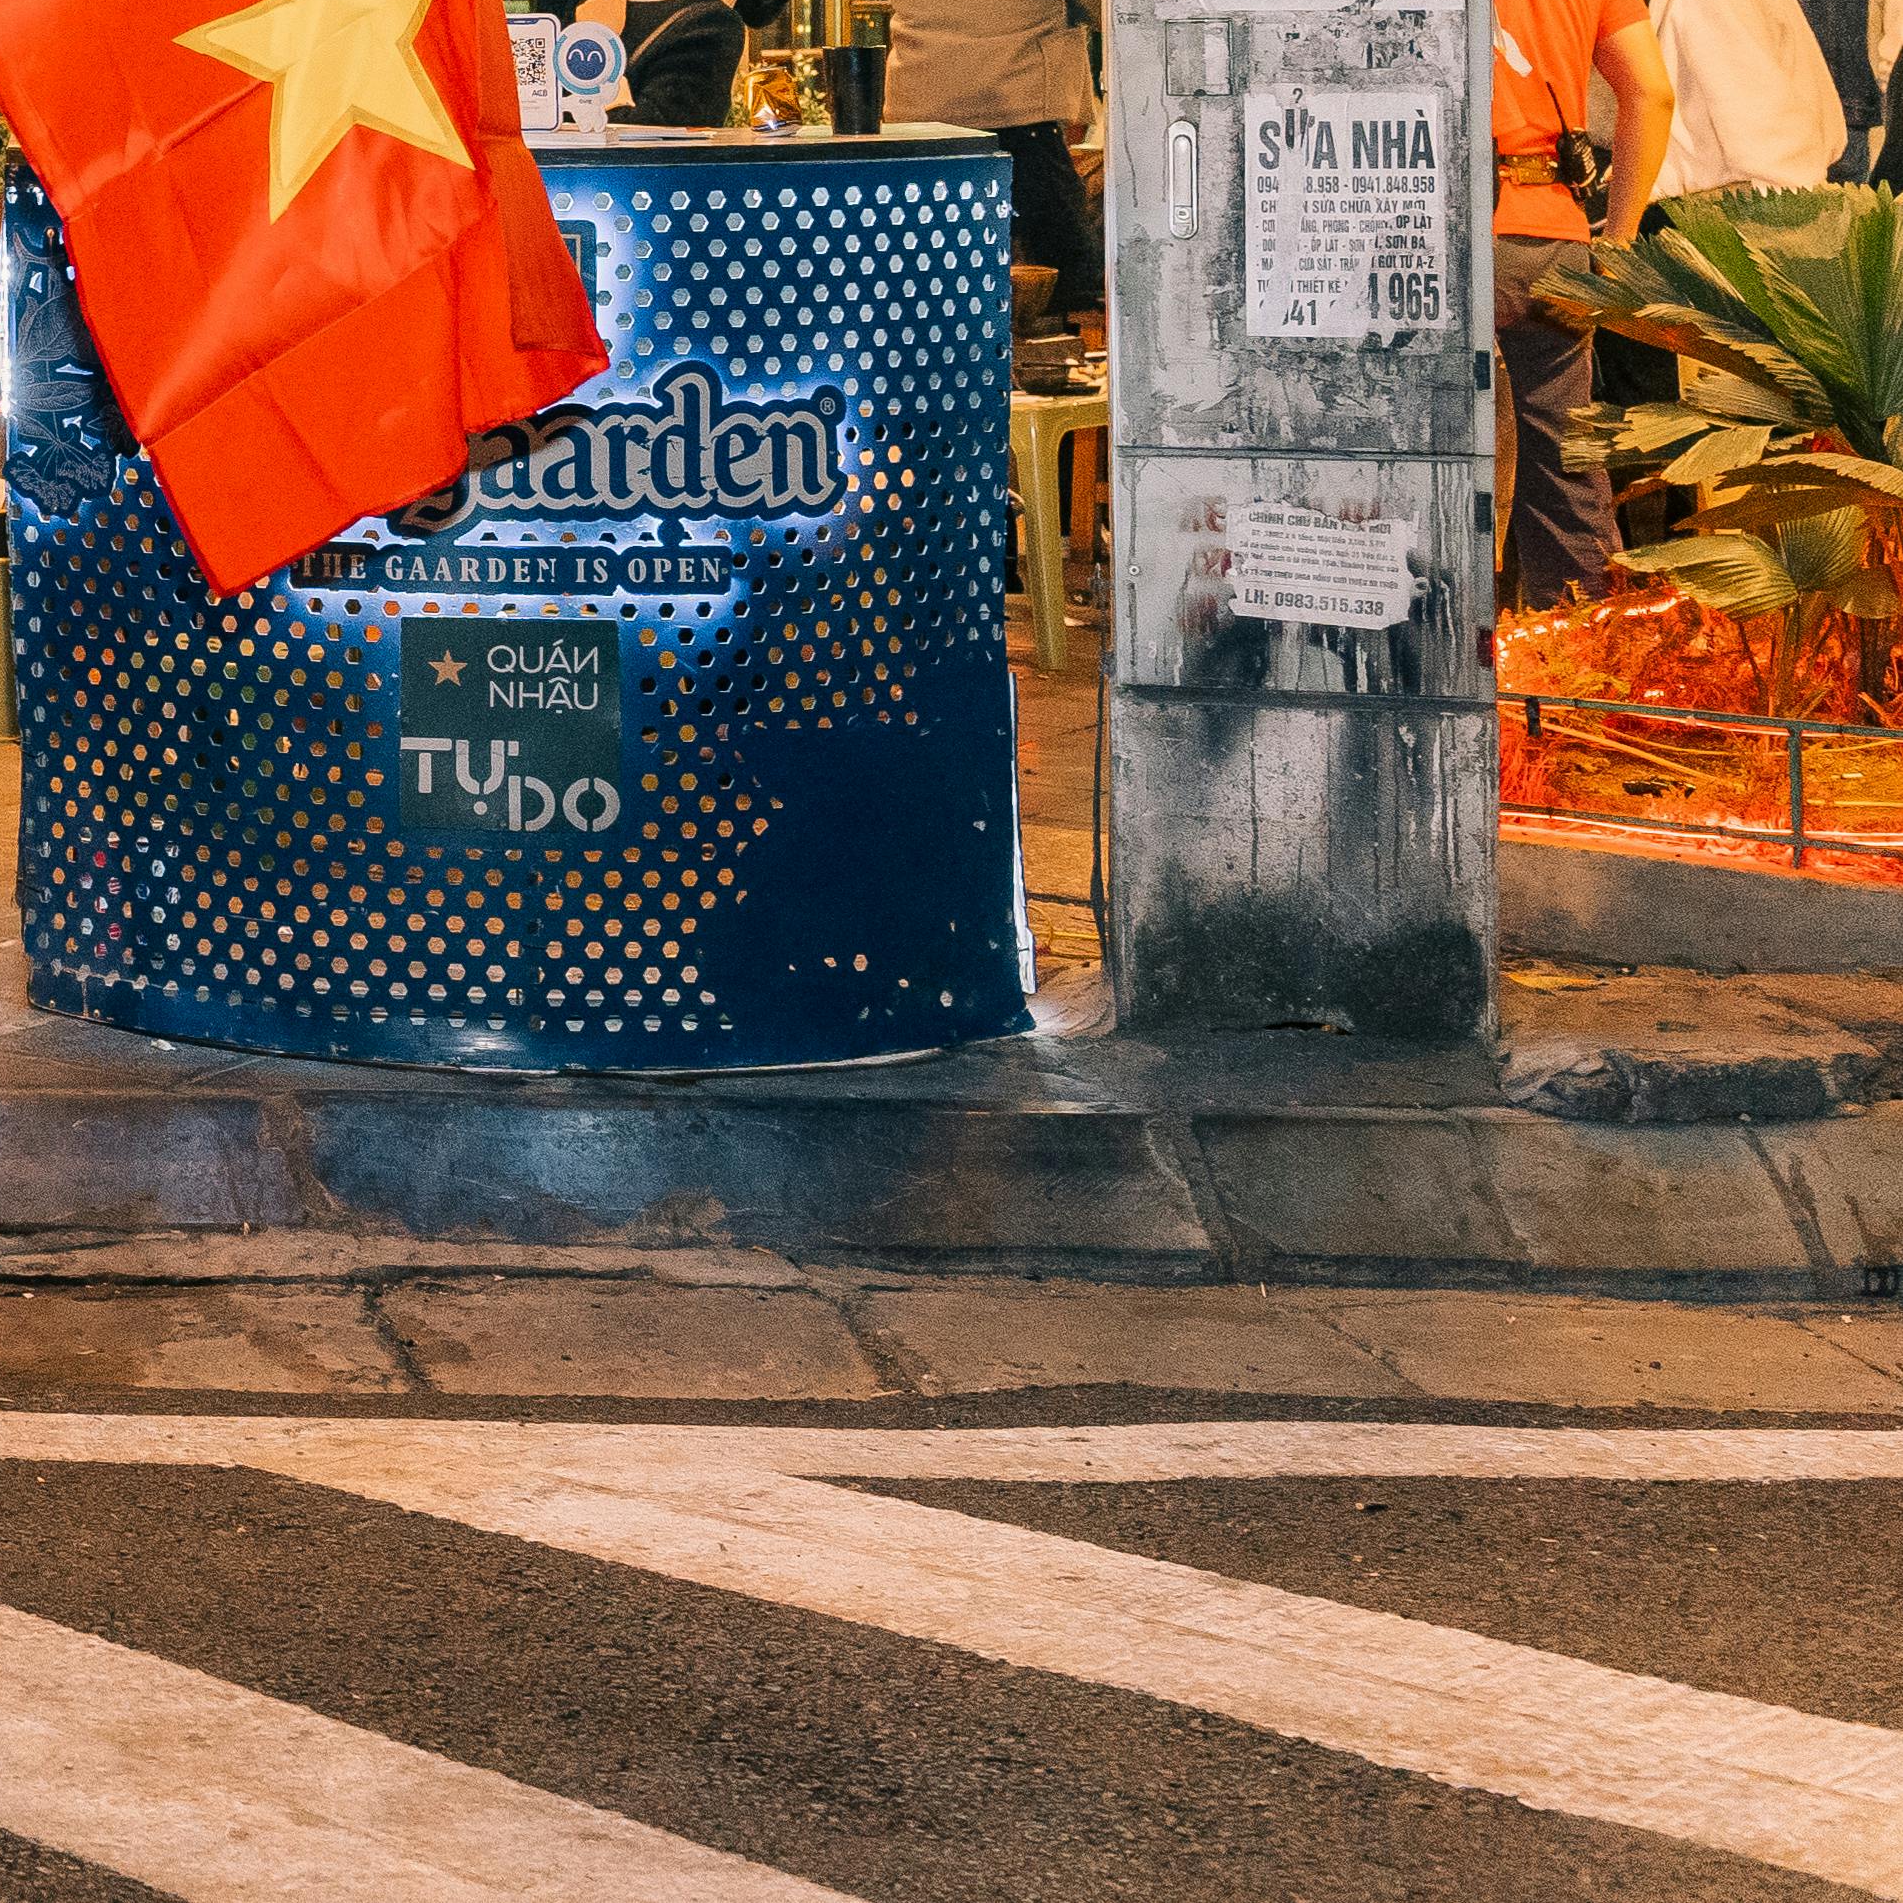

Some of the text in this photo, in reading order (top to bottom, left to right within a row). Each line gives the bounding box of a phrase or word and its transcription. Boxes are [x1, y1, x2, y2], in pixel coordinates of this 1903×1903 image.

[1352, 109, 1436, 169] NHÀ
[1352, 176, 1435, 193] 0941.848.958
[1416, 256, 1434, 269] A-Z
[301, 554, 722, 584] THE GAARDEN IS OPEN
[489, 676, 598, 714] NHẬU
[400, 737, 621, 831] TỰ DO
